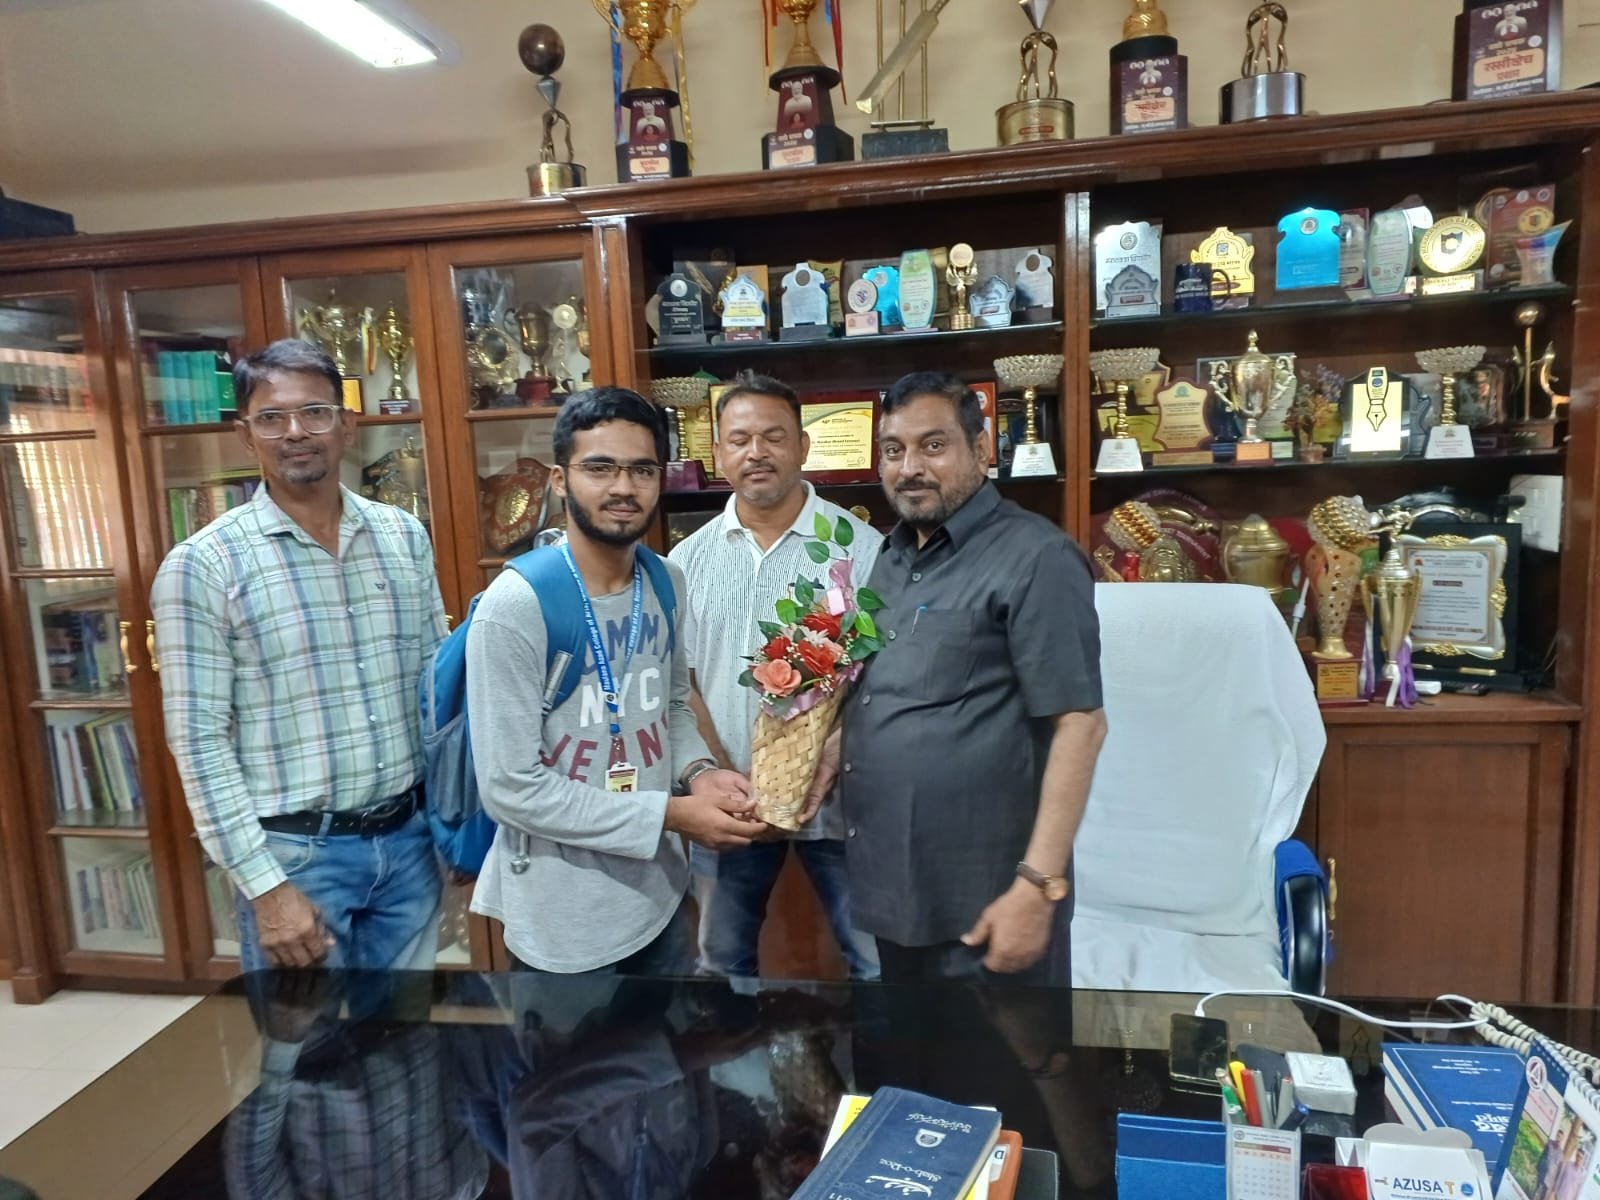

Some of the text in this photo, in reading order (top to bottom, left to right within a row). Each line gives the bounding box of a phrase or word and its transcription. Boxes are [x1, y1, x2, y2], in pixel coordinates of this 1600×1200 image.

[580, 666, 660, 728] NYC
[539, 715, 669, 783] JEAN
[1393, 1176, 1444, 1194] AZUSA
